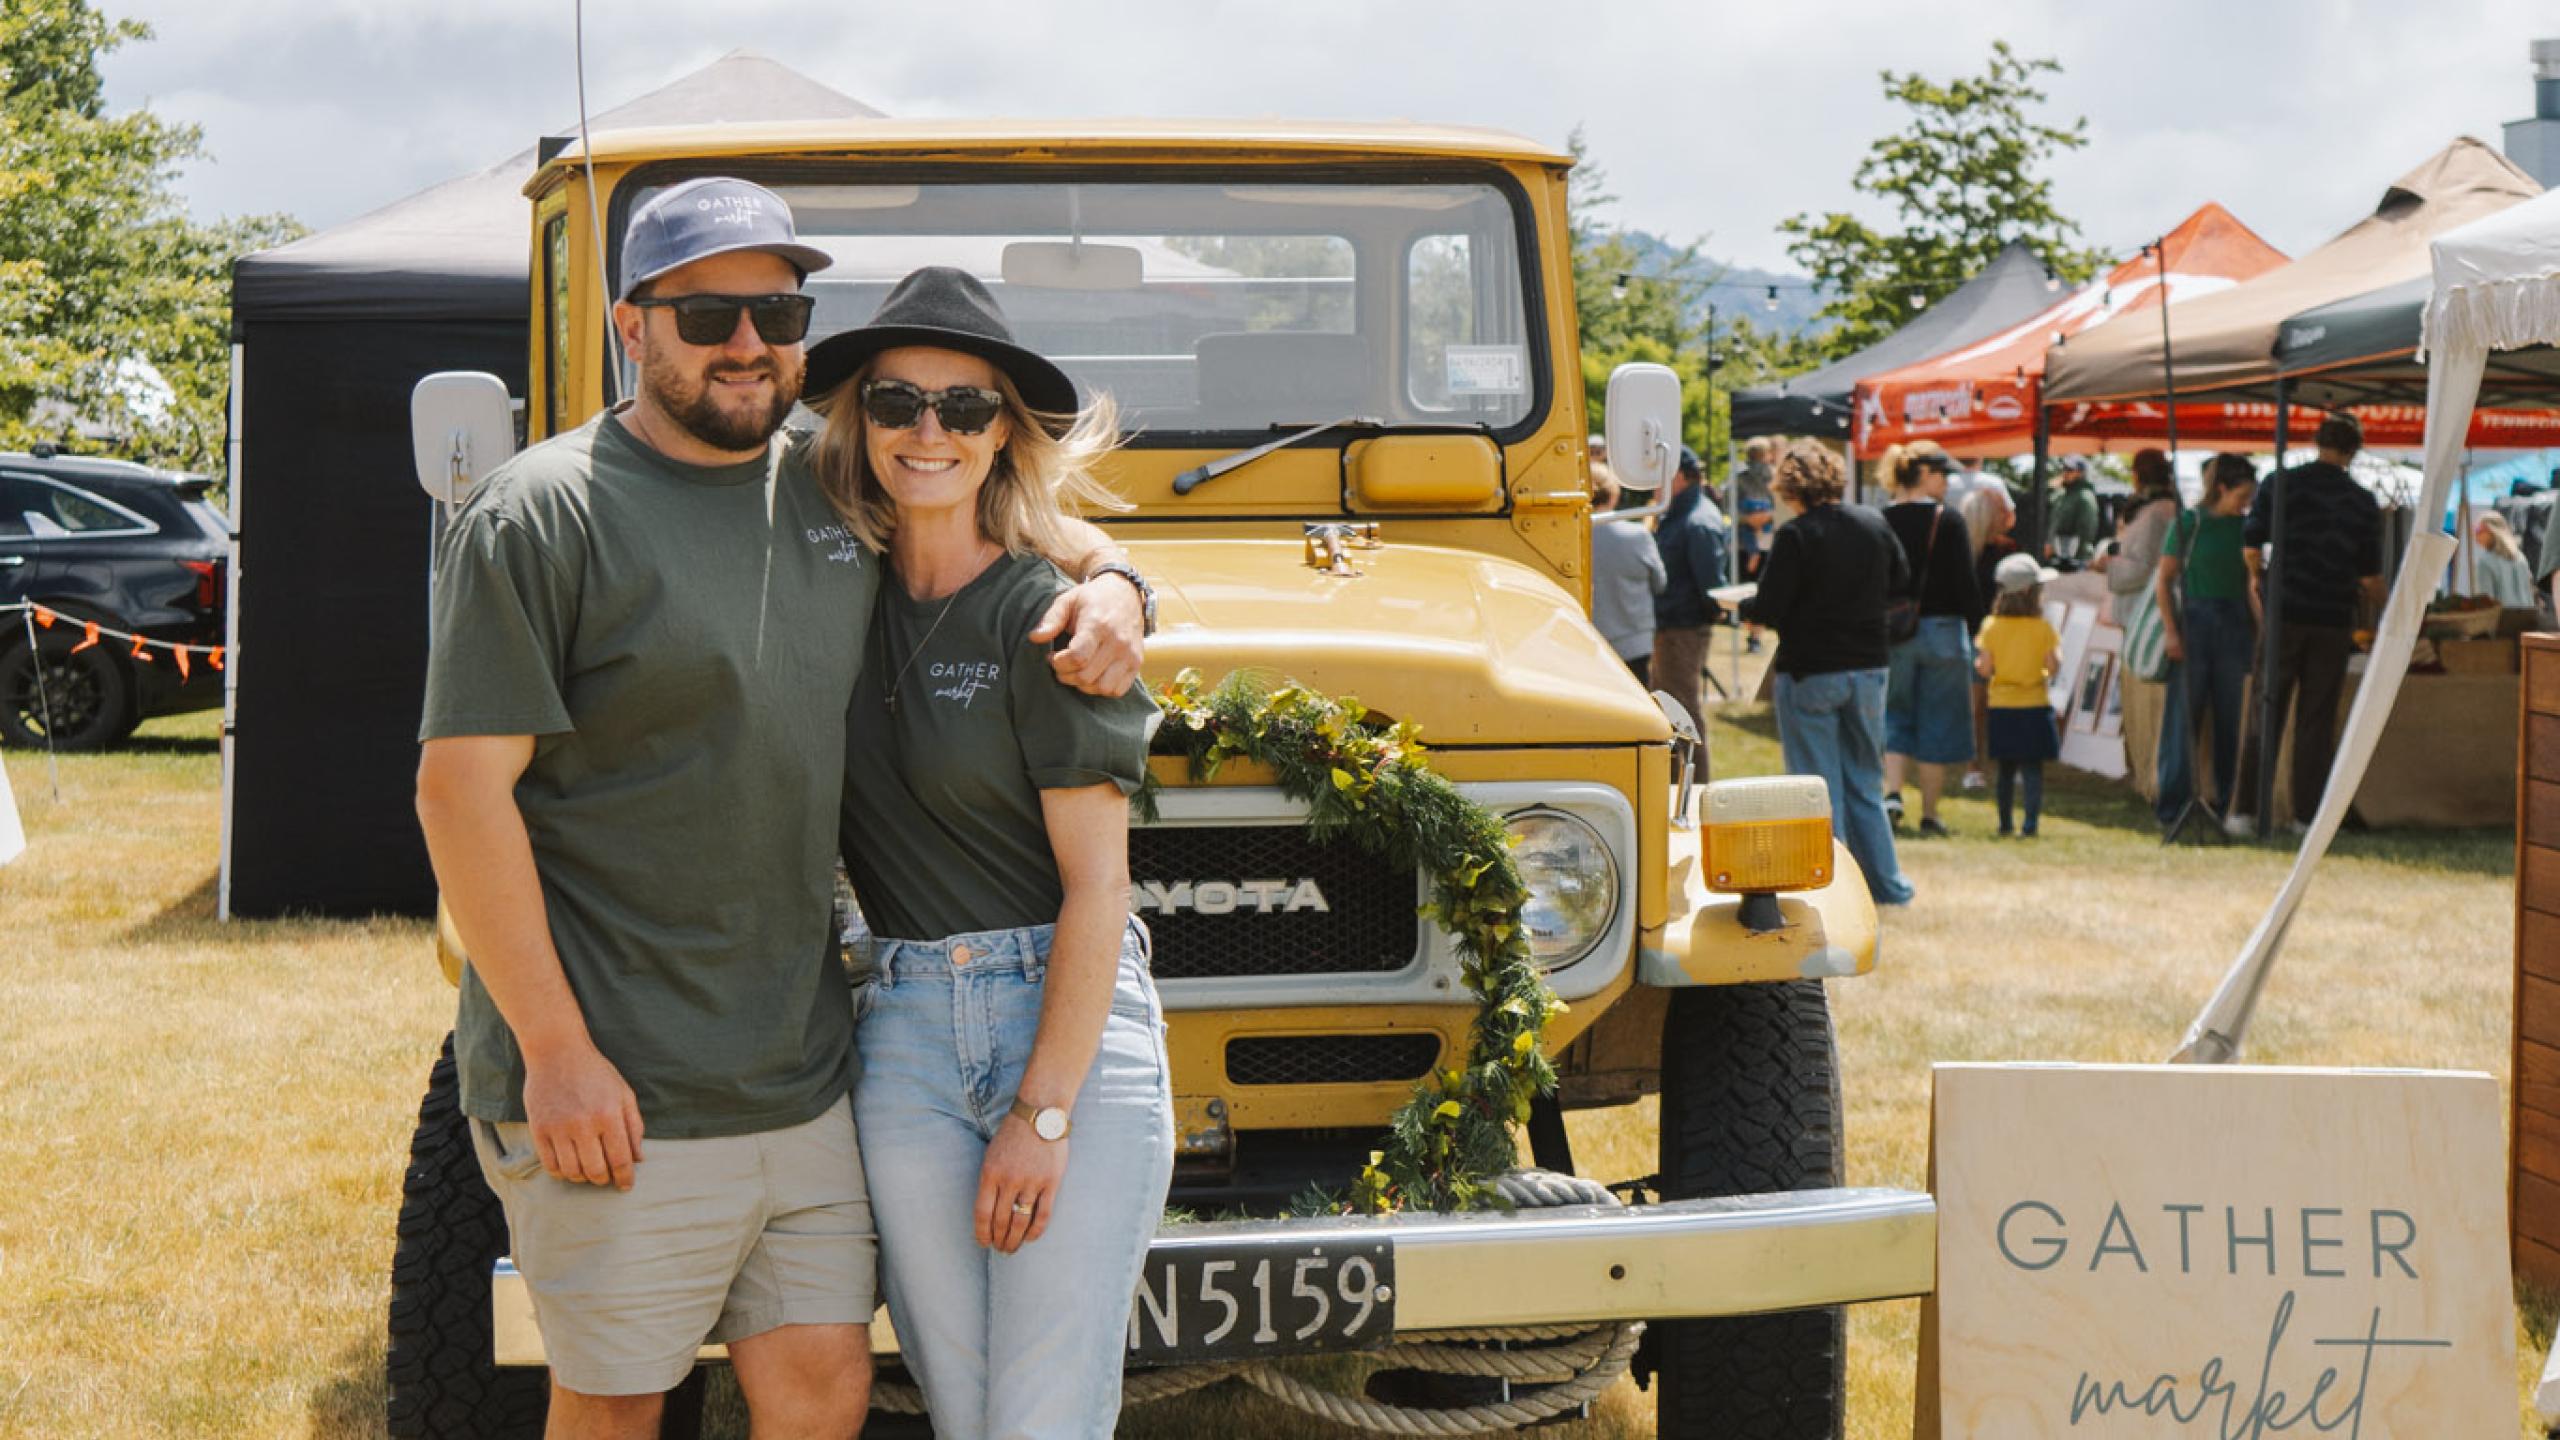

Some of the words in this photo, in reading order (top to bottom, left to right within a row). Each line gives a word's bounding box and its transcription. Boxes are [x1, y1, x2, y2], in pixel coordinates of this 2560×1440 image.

[697, 196, 763, 212] GATHER
[807, 526, 854, 543] GATHE
[929, 661, 1000, 680] GATHER
[1130, 877, 1330, 915] YOTA
[1996, 1200, 2419, 1279] GATHER
[2069, 1290, 2452, 1440] market
